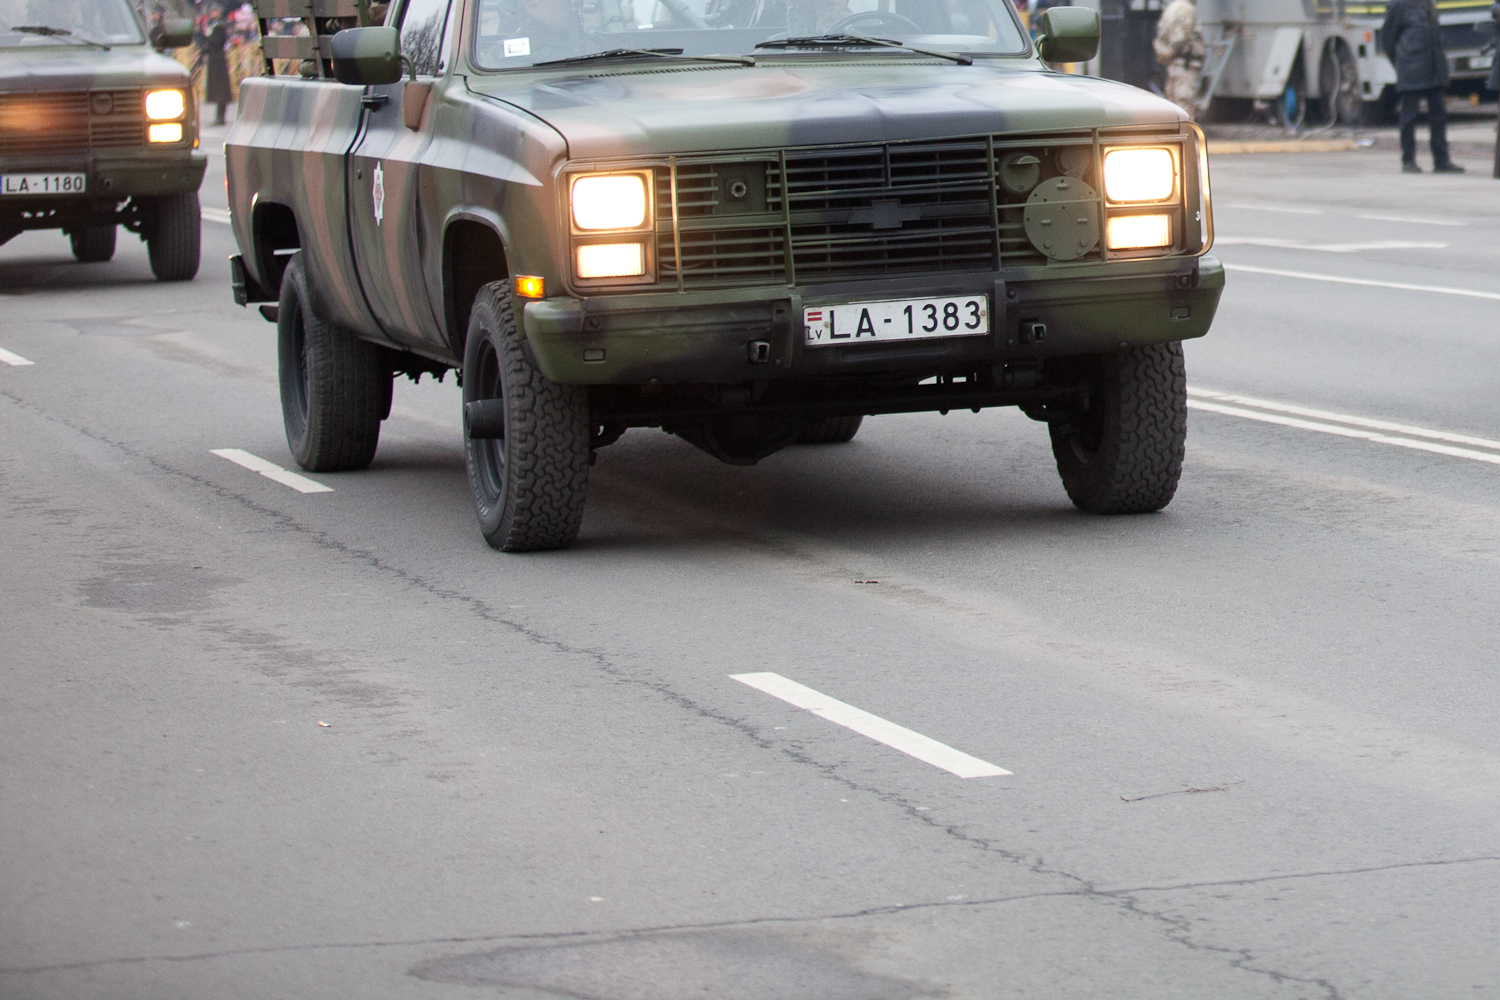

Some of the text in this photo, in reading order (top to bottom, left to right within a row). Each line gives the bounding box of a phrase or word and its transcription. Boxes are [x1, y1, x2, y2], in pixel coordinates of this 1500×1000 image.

[5, 176, 83, 192] LA-1180
[807, 300, 982, 341] LV LA-1383
